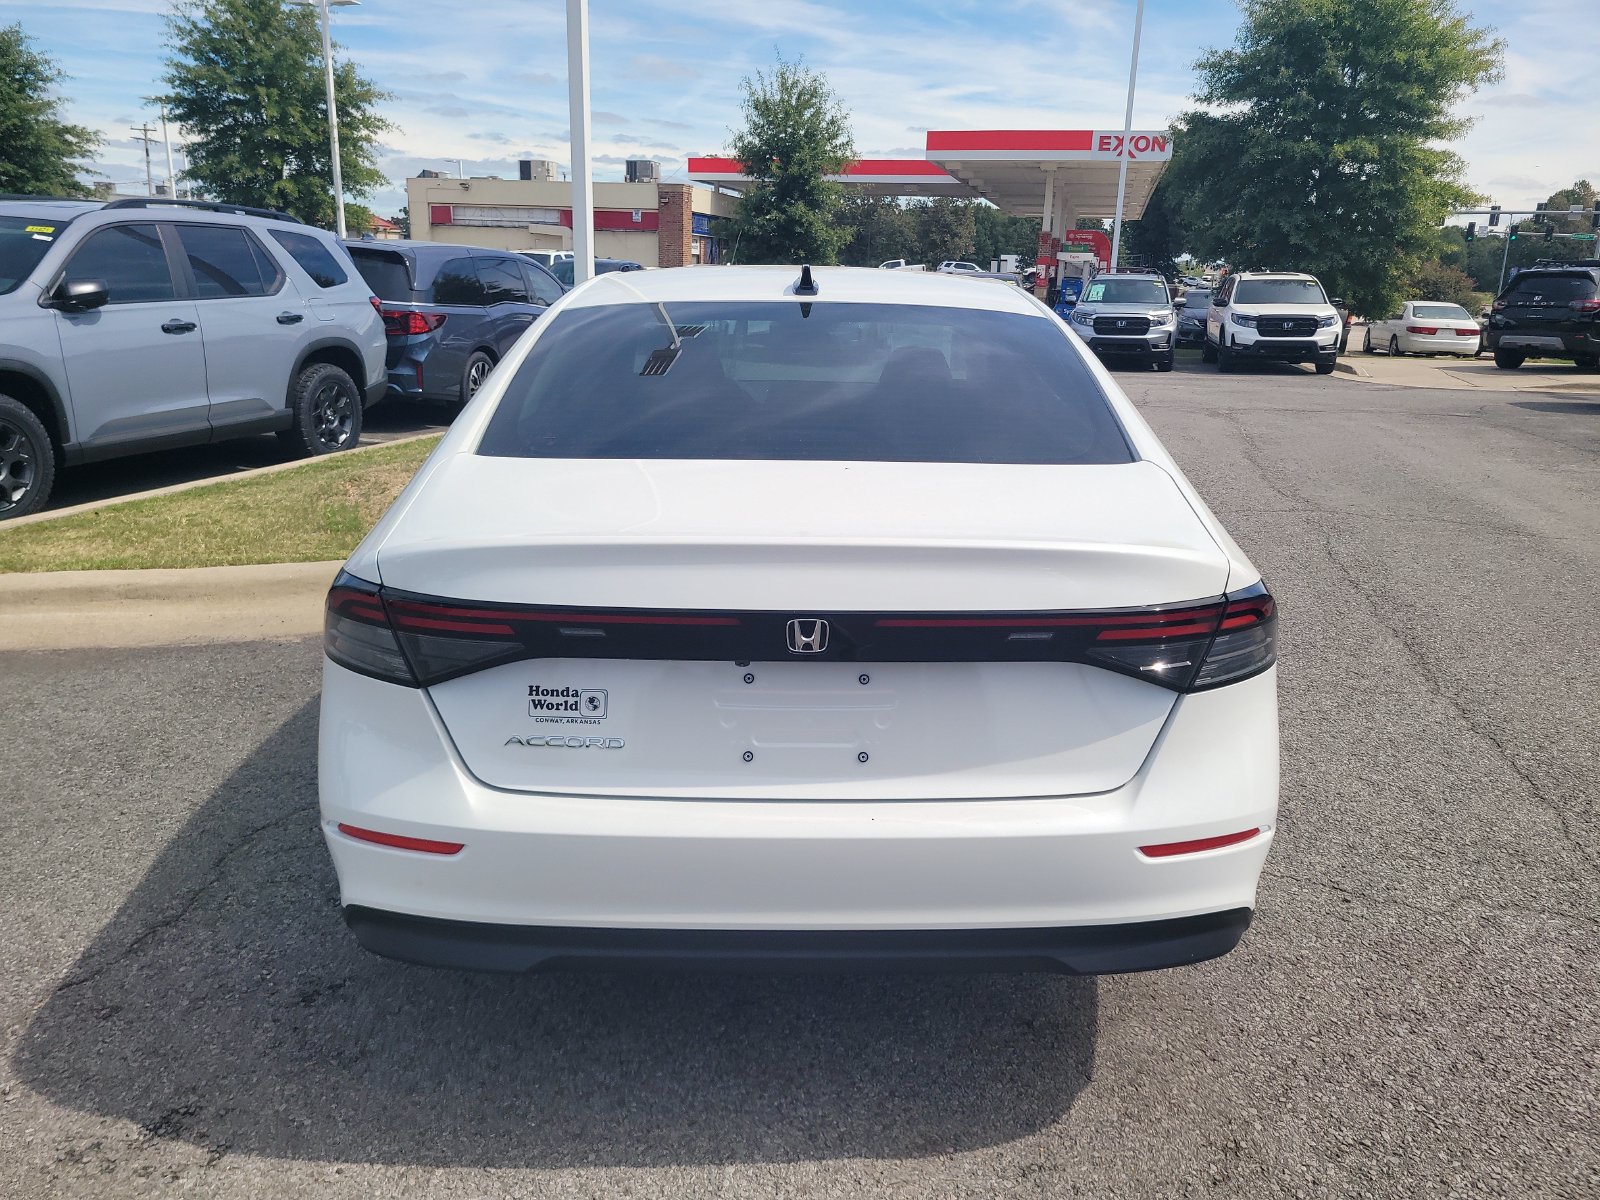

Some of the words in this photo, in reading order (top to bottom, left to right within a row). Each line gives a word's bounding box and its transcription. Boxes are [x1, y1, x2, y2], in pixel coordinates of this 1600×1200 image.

[528, 685, 580, 698] Honda
[531, 699, 579, 712] World
[535, 717, 565, 725] CONWAY,
[504, 734, 626, 749] ACCORD
